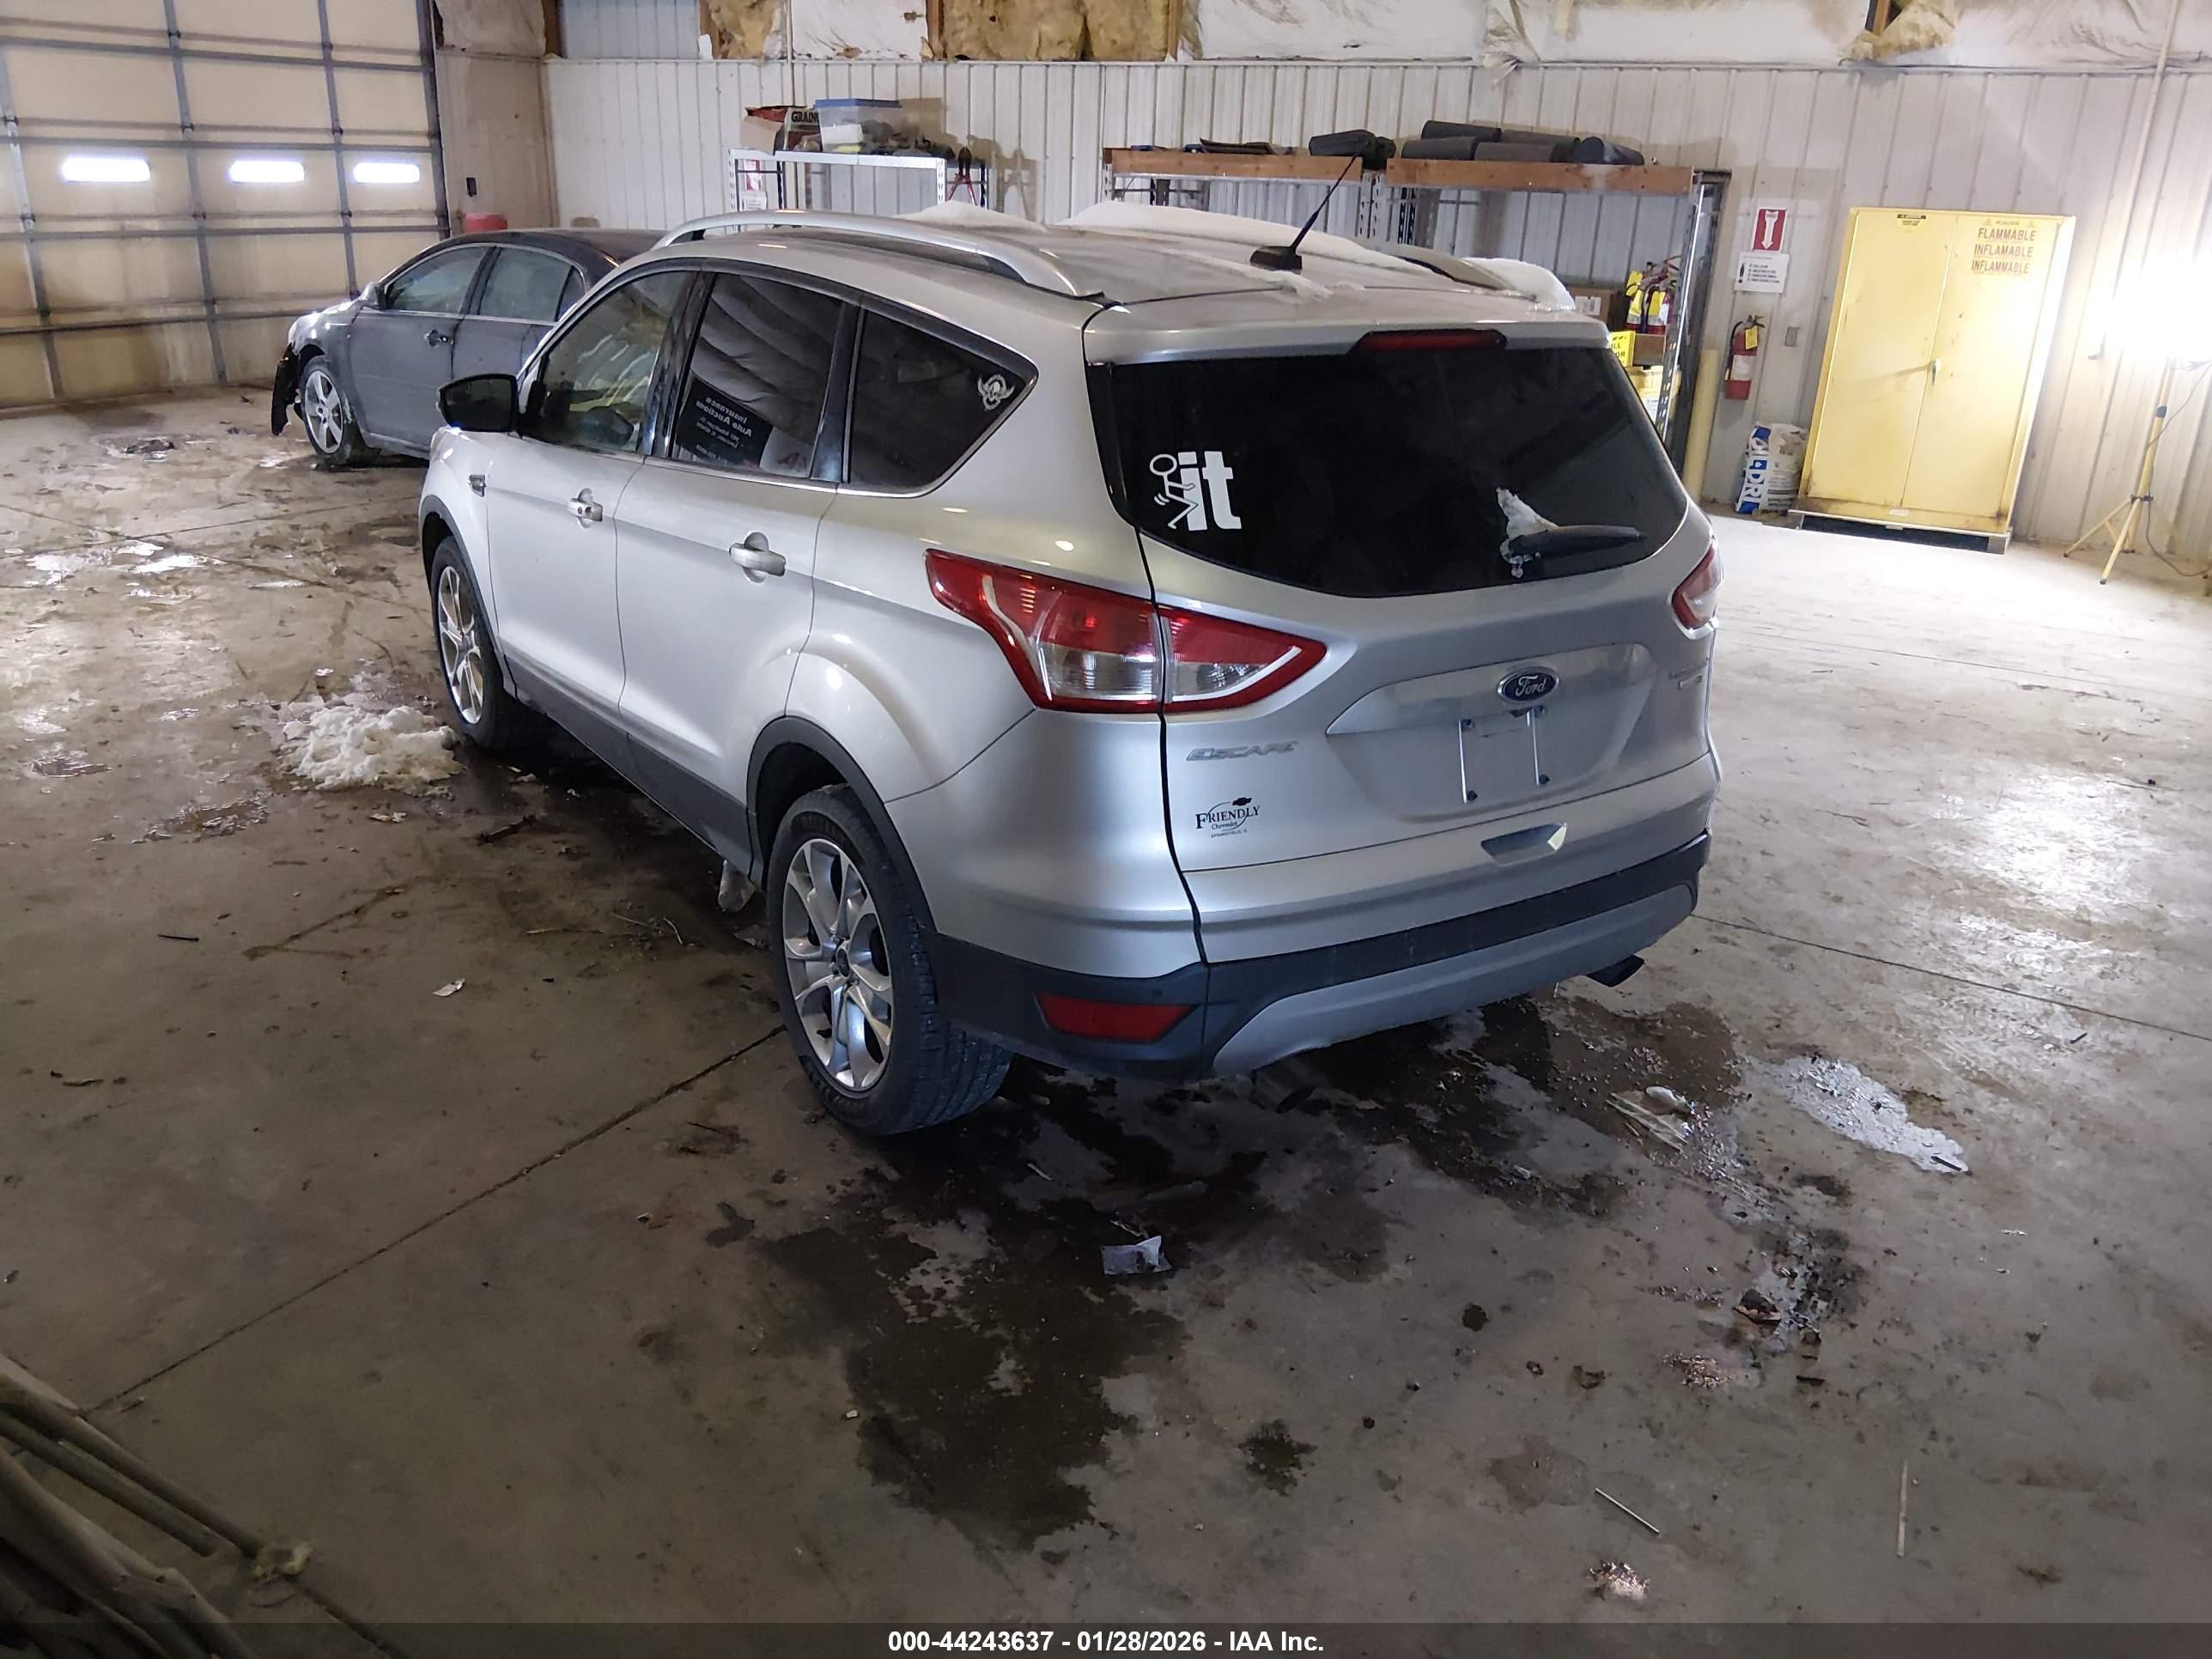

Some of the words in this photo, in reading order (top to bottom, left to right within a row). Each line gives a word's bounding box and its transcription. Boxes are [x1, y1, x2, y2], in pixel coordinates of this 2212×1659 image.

[1978, 228, 2037, 241] FLAMMABLE
[1974, 243, 2033, 258] INFLAMABLE
[1972, 259, 2030, 274] INFLAMMABLE
[1515, 675, 1547, 696] Ford
[1186, 741, 1299, 761] ESCAPE
[1194, 805, 1260, 830] FRIENDLY
